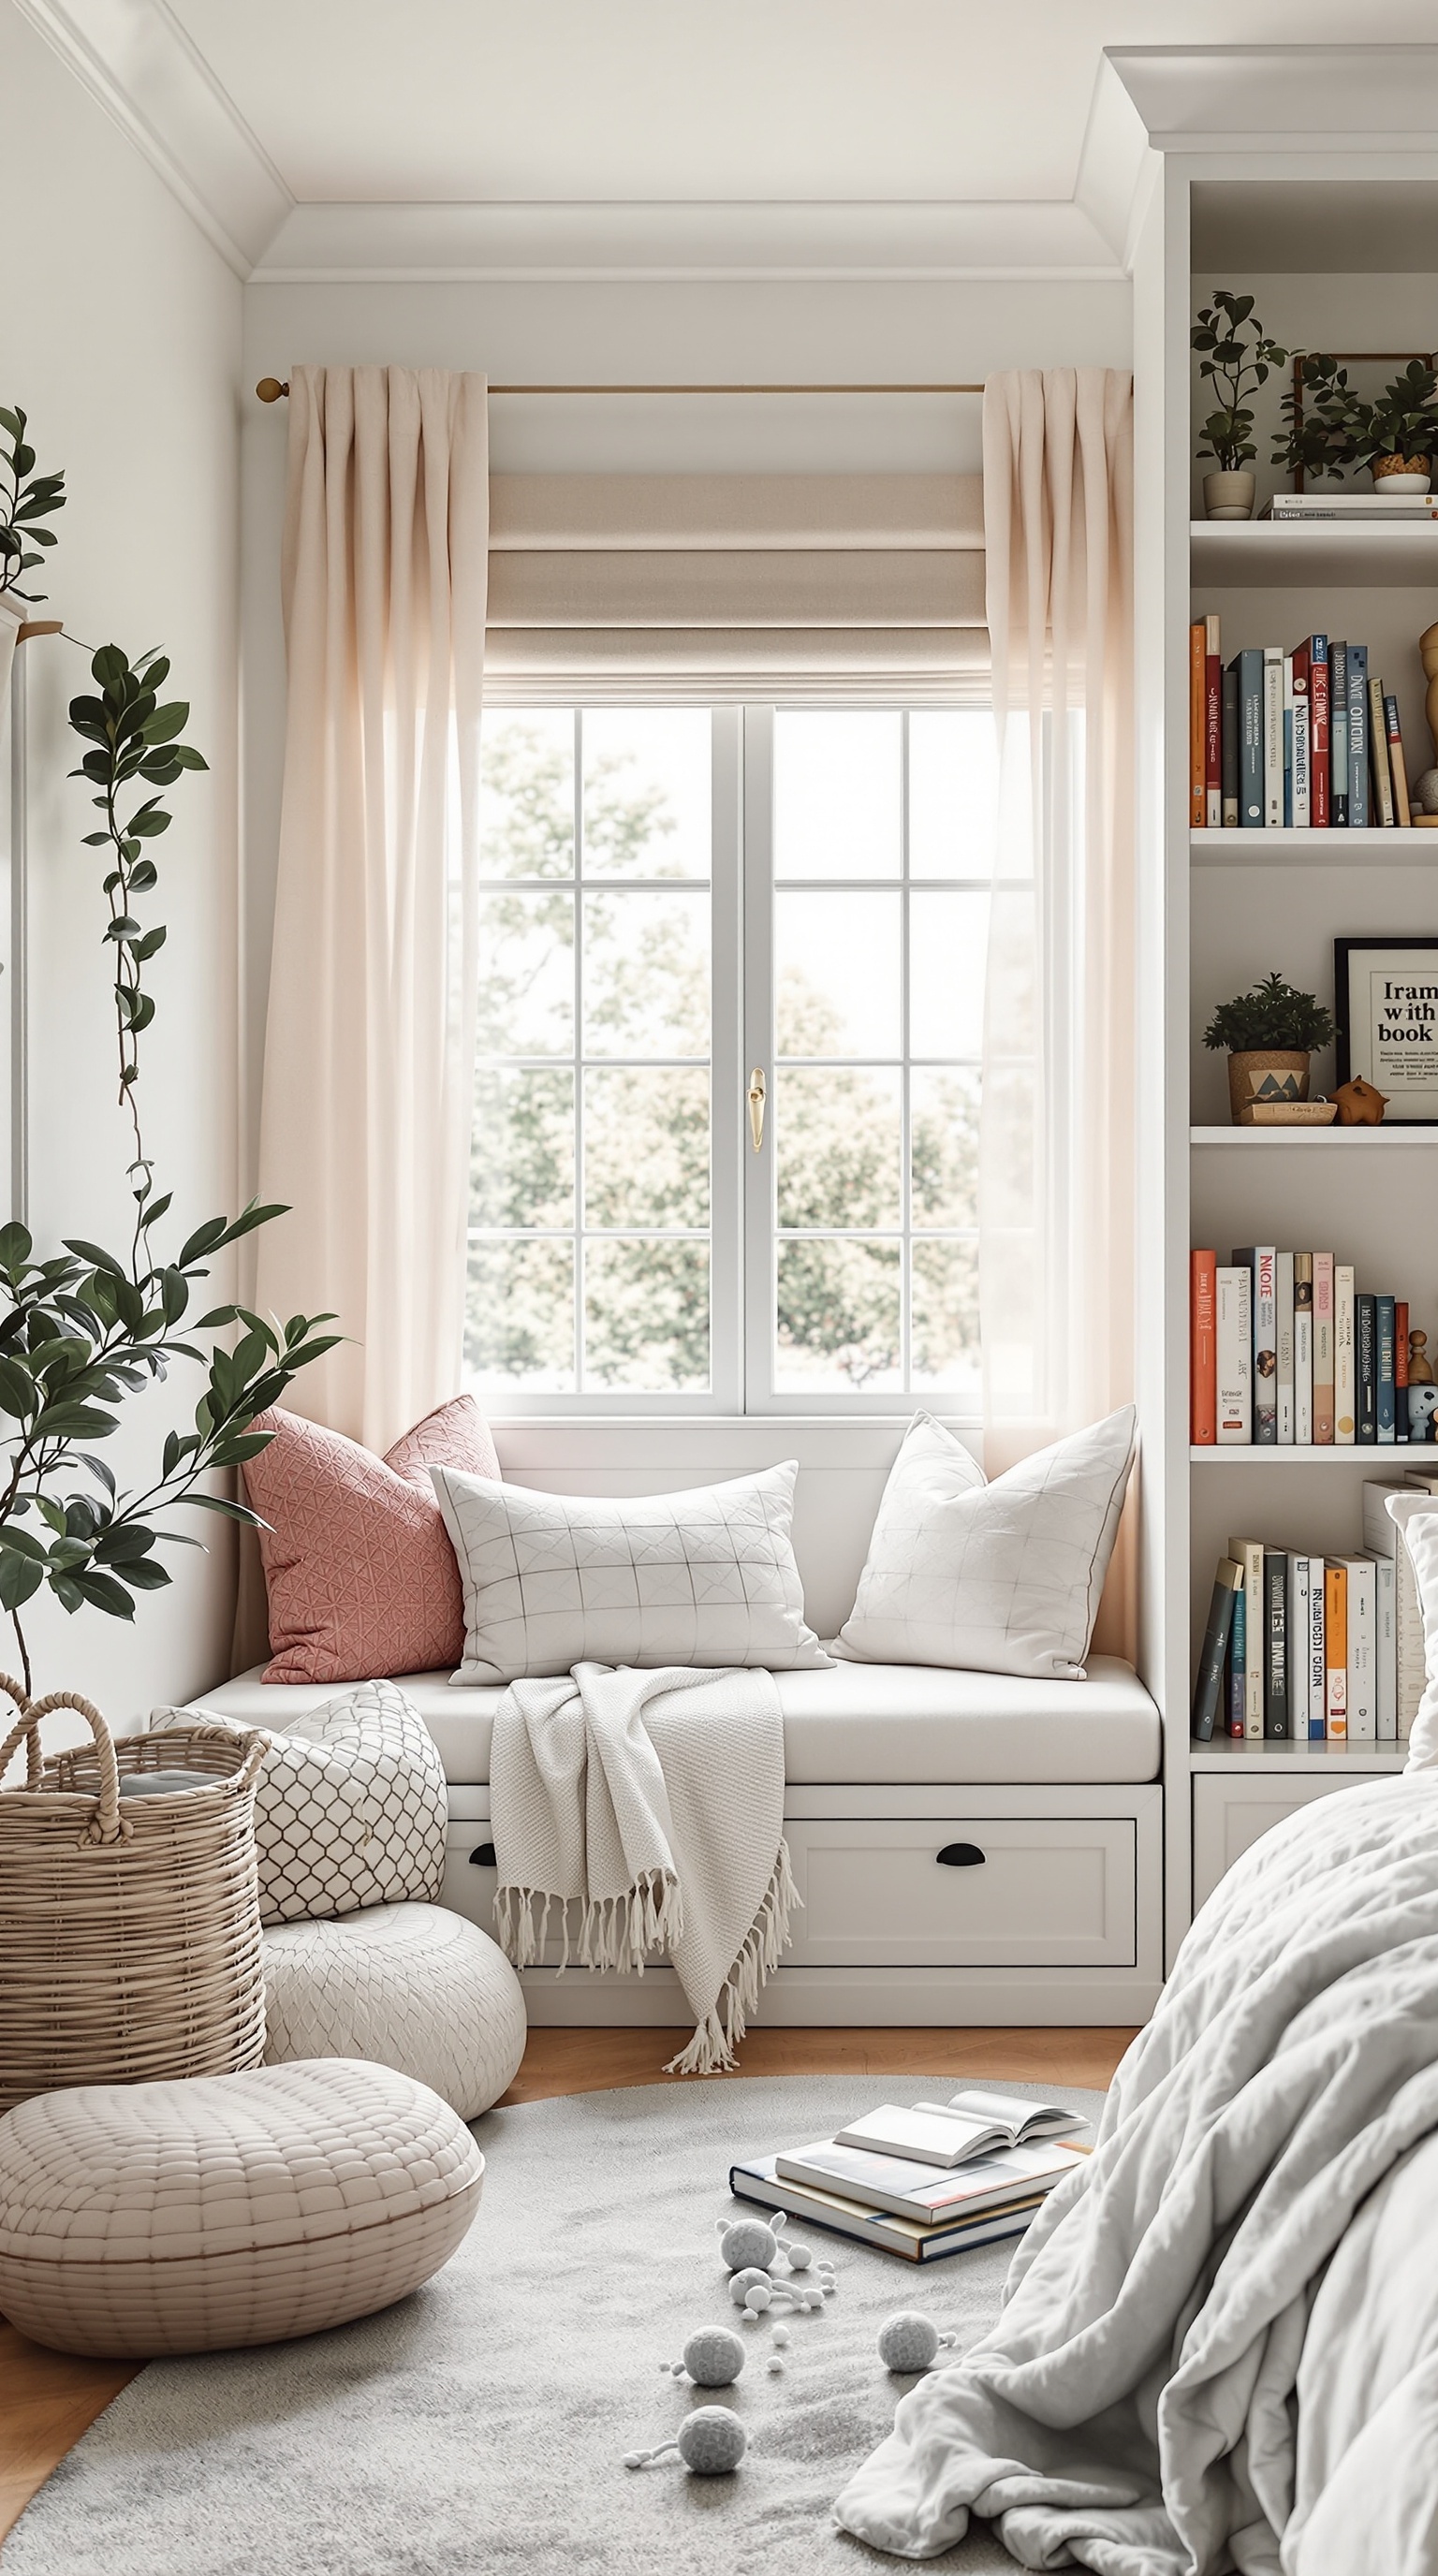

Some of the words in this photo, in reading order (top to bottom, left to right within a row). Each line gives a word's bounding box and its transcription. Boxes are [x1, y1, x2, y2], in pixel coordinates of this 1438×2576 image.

[1384, 982, 1438, 1000] Iram
[1384, 1003, 1436, 1020] with
[1377, 1023, 1433, 1042] book
